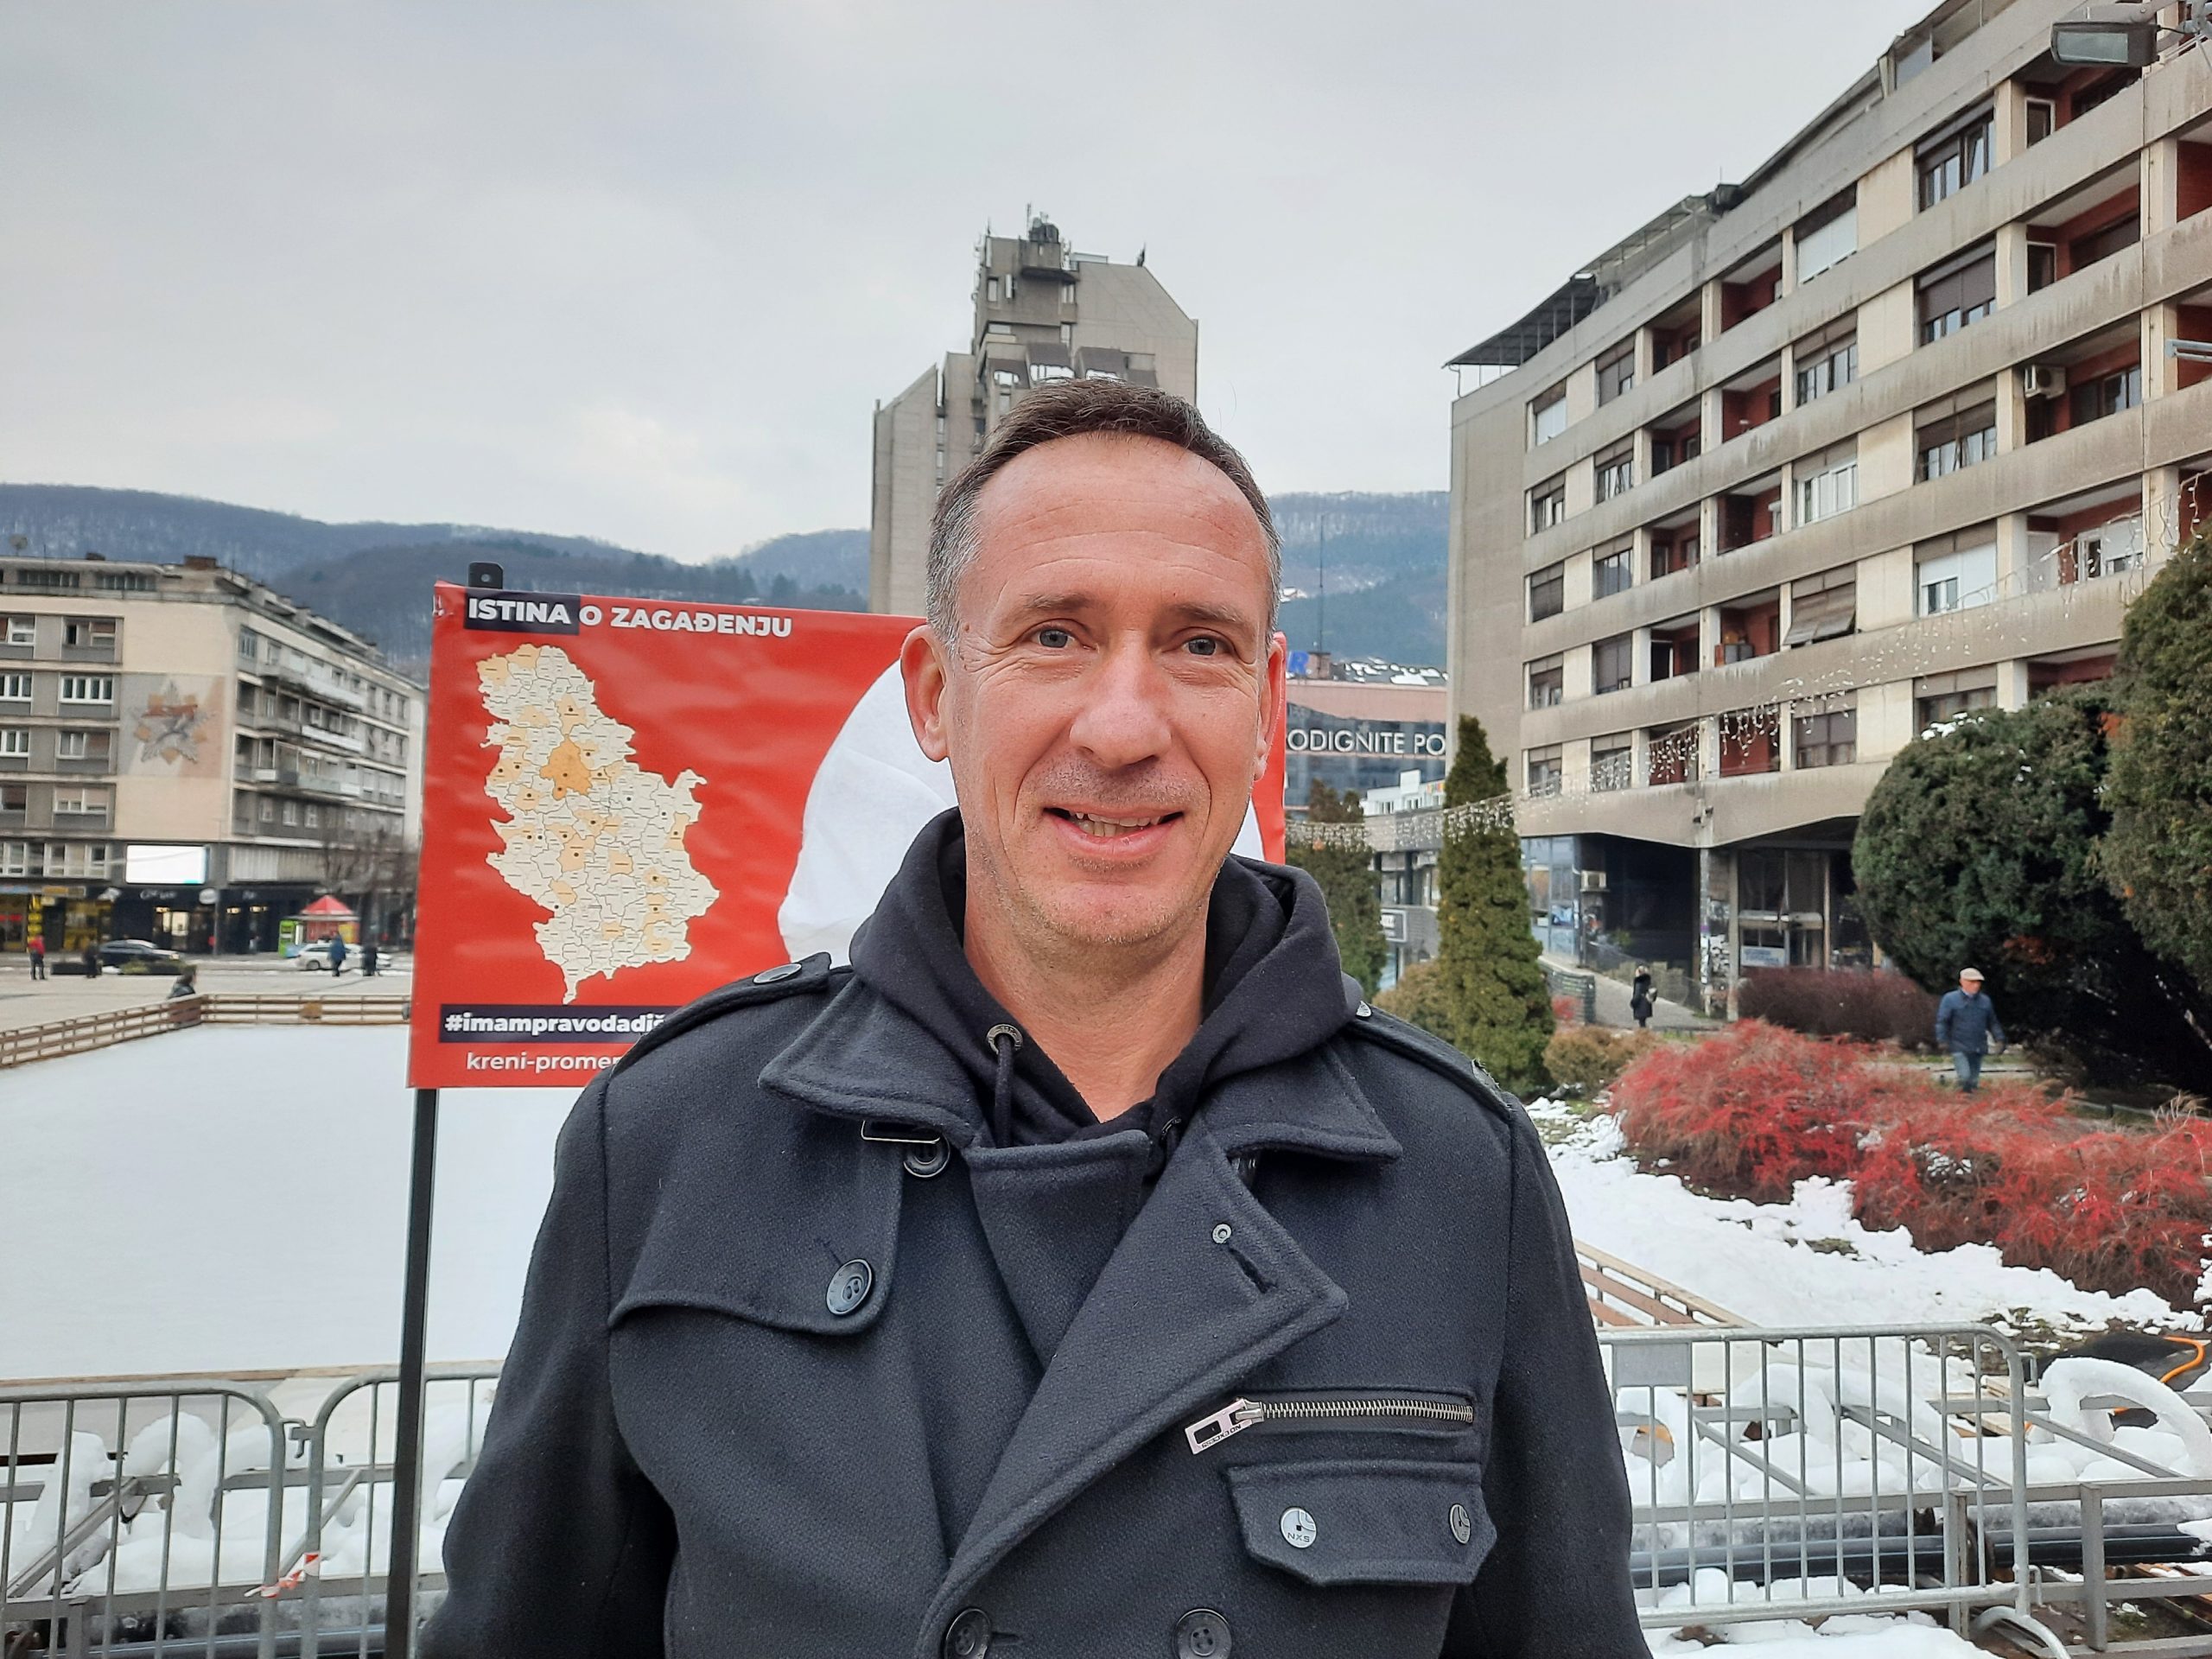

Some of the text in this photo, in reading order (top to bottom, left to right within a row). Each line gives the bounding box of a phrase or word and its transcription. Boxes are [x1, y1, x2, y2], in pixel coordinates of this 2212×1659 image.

[467, 597, 792, 638] ISTINA O ZAGAĐENJU
[1287, 728, 1446, 756] ODIGNITE PO
[1287, 1532, 1310, 1543] NXS
